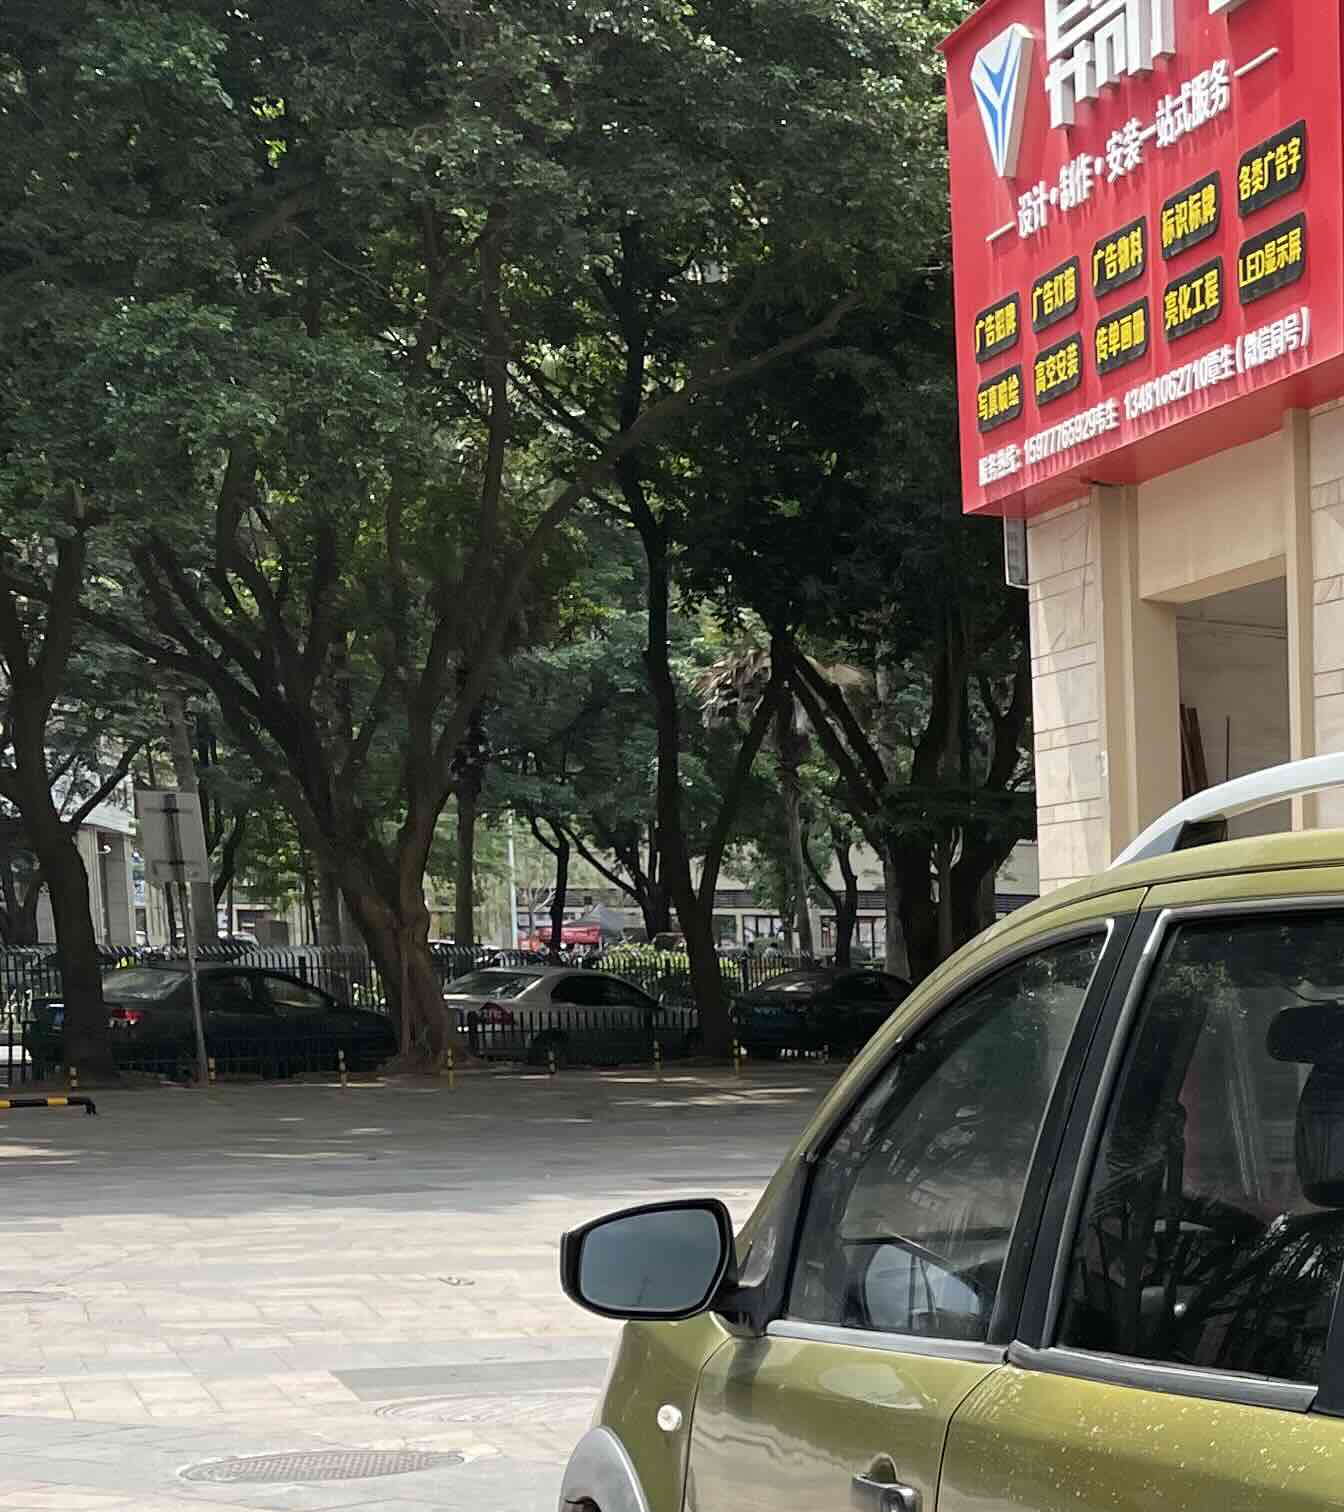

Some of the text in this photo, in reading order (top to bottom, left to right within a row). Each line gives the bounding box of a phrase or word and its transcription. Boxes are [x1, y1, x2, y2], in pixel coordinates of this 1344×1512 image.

[1165, 268, 1219, 330] 亮化工程
[1239, 227, 1302, 288] LED显示屏
